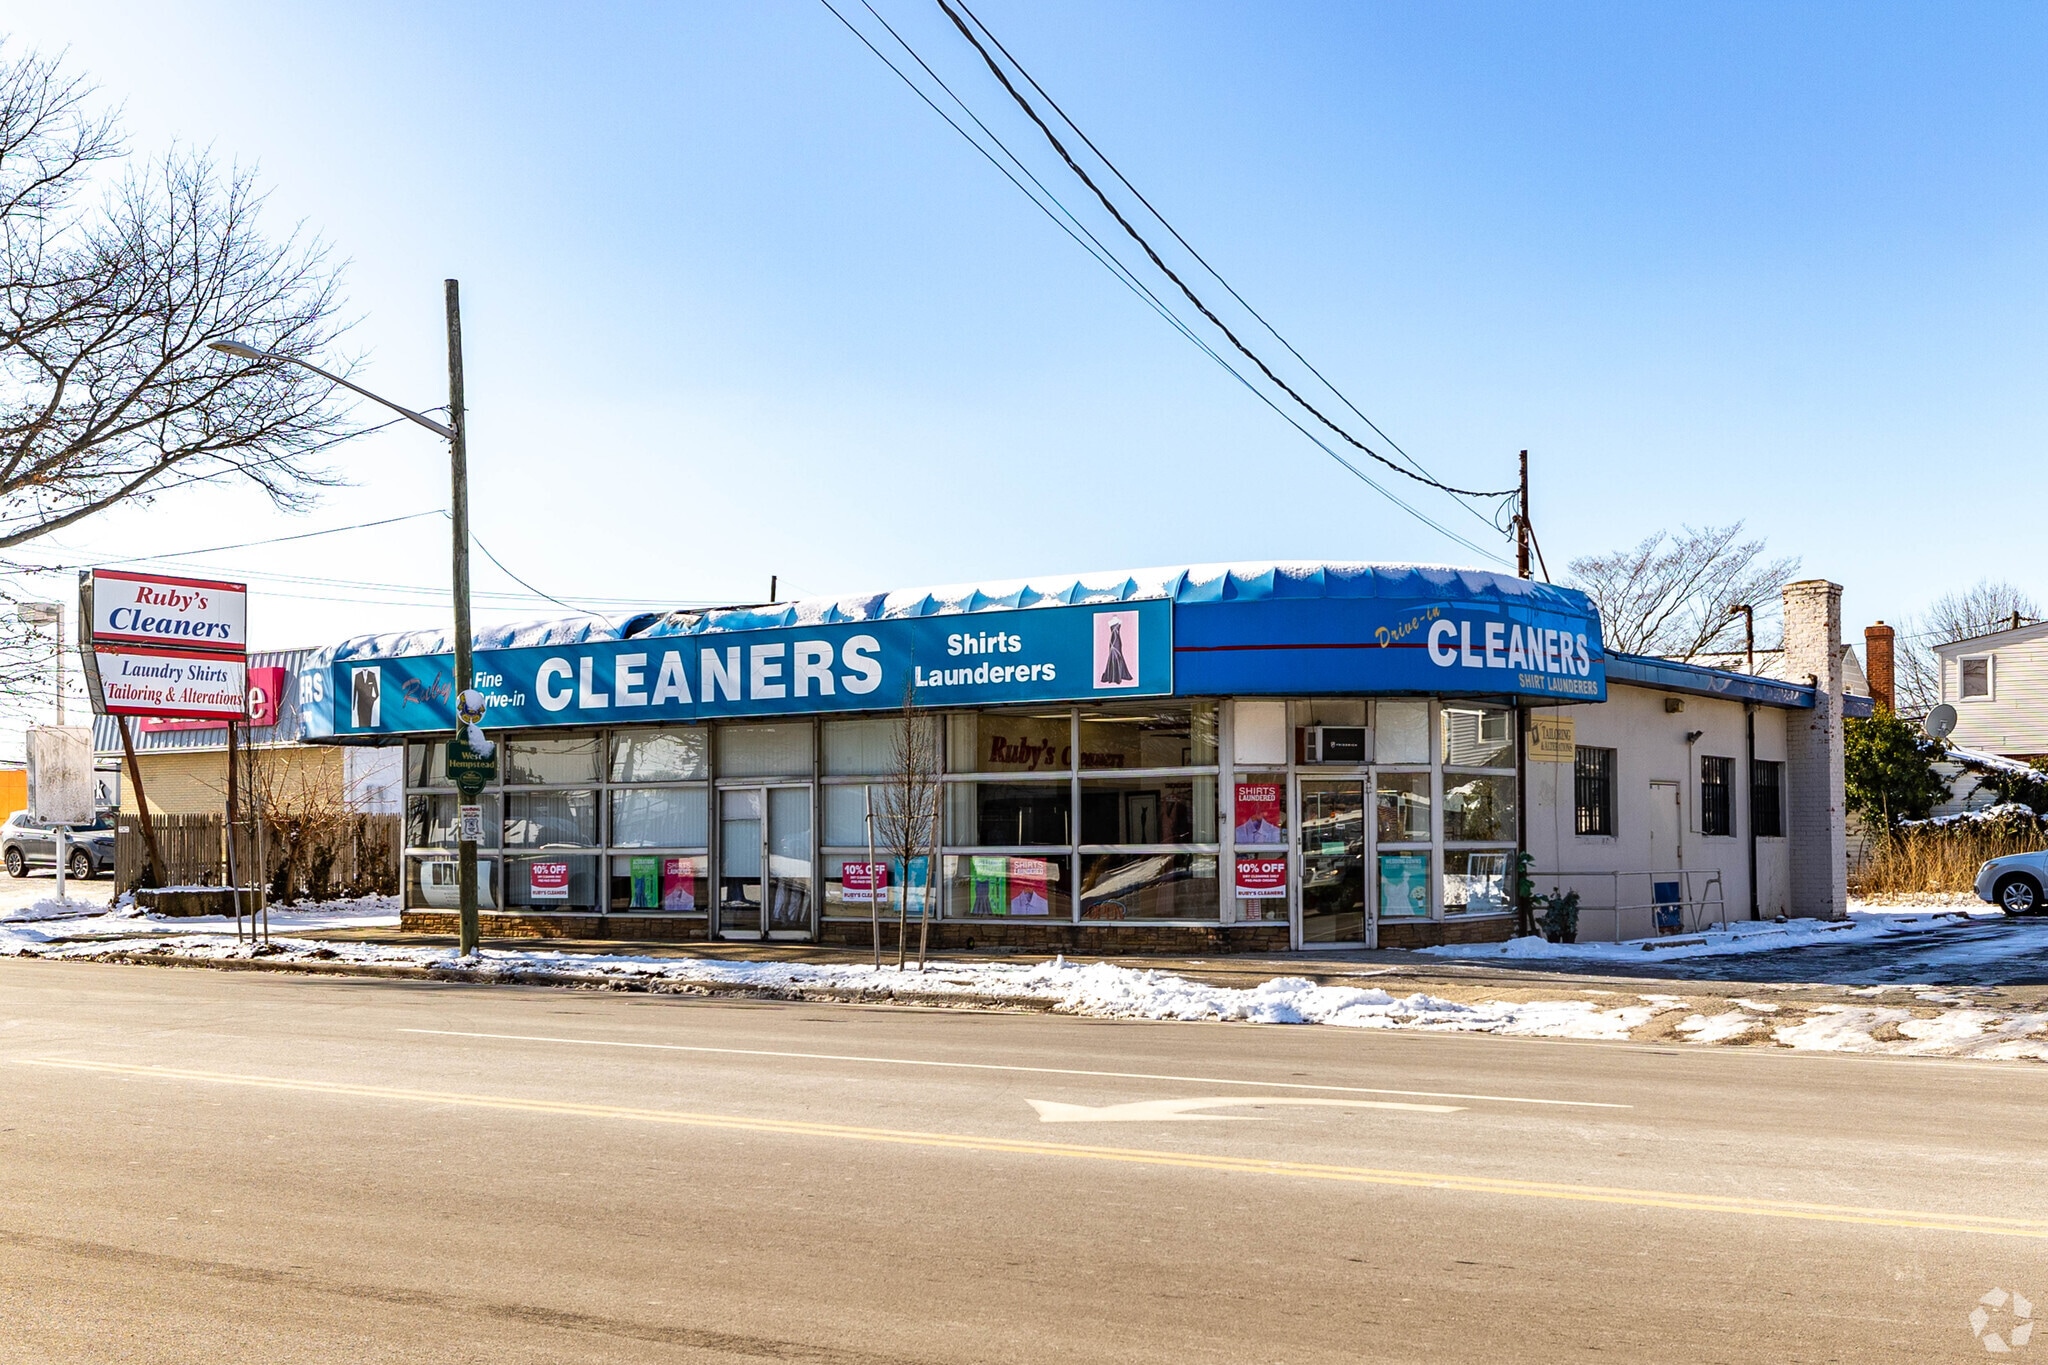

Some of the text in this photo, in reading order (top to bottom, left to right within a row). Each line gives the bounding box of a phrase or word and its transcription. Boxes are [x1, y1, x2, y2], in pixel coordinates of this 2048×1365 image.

[134, 586, 209, 612] Ruby's
[109, 607, 231, 639] Cleaners
[1374, 606, 1441, 648] Drive-in
[947, 631, 1022, 656] Shirts
[1427, 619, 1590, 677] CLEANERS
[121, 660, 228, 683] Laundry Shirts
[474, 671, 503, 689] Fine
[535, 634, 882, 712] CLEANERS
[914, 662, 1056, 687] Launderers
[107, 682, 163, 705] Tailoring
[165, 686, 176, 702] &
[178, 687, 244, 706] Alterations
[1518, 673, 1598, 695] SHIRT LAUNDERERS
[449, 759, 495, 769] Hempstead
[989, 735, 1056, 771] Ruby's
[1238, 787, 1276, 795] SHIRTS
[533, 865, 567, 874] 10% OFF
[844, 864, 864, 875] 10%
[1237, 863, 1285, 873] 10% OFF
